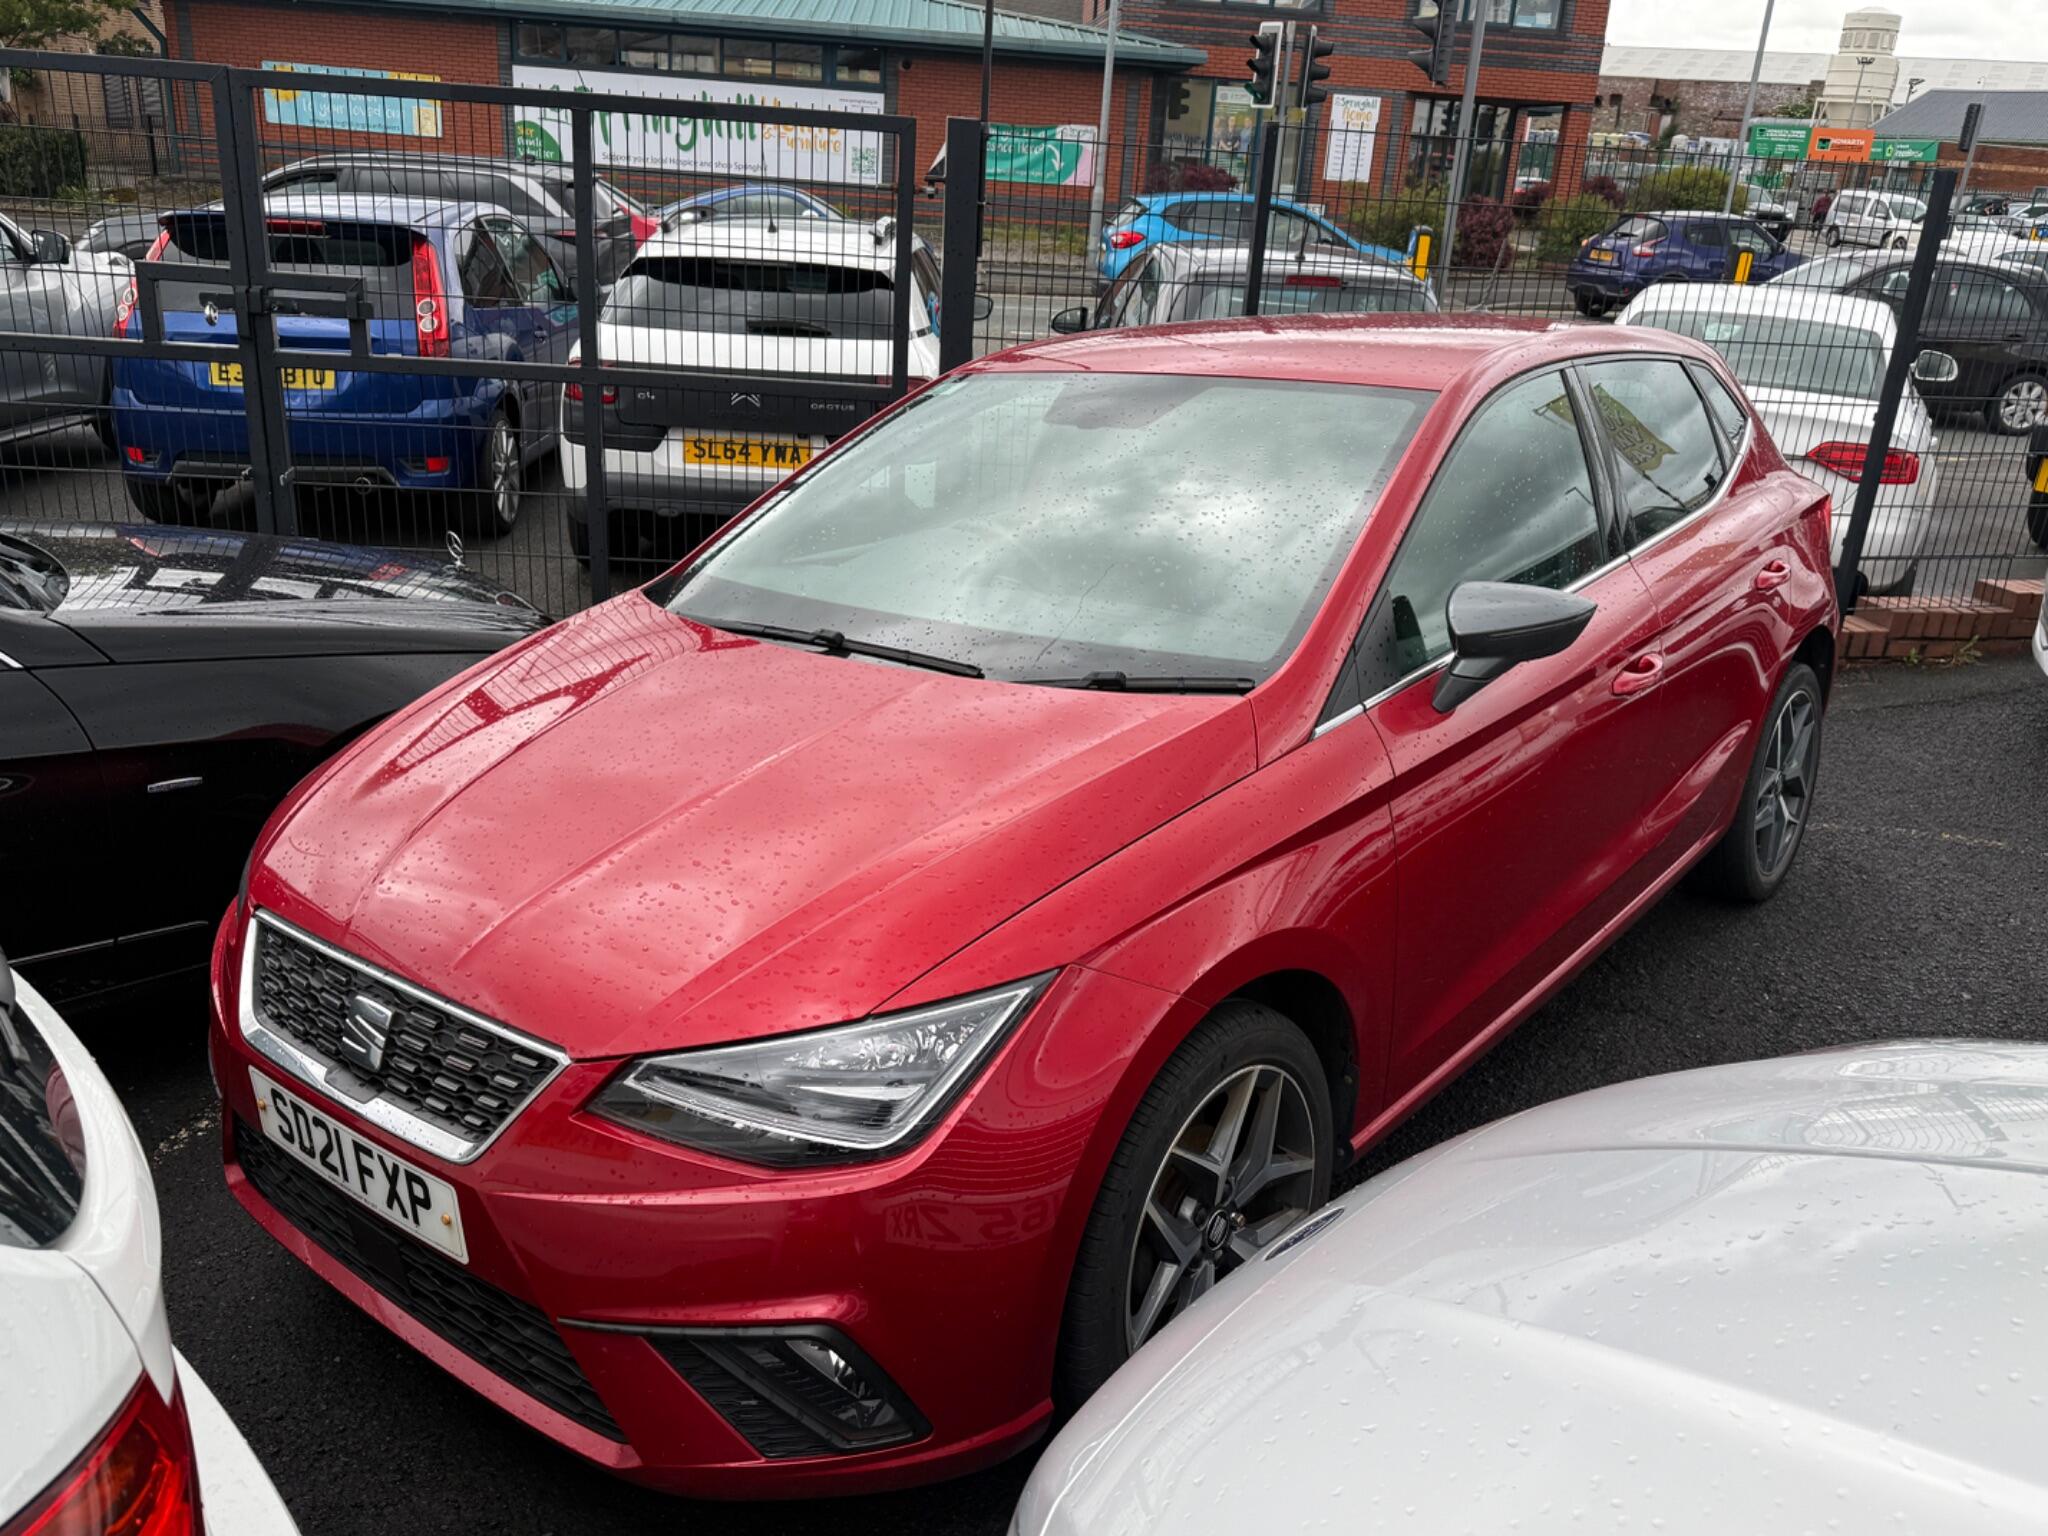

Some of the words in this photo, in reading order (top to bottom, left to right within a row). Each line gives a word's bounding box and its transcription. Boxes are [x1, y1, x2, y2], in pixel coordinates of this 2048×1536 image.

[693, 438, 751, 461] SL64
[759, 442, 802, 465] YWA
[270, 1087, 350, 1183] SD21
[351, 1142, 432, 1228] FXP
